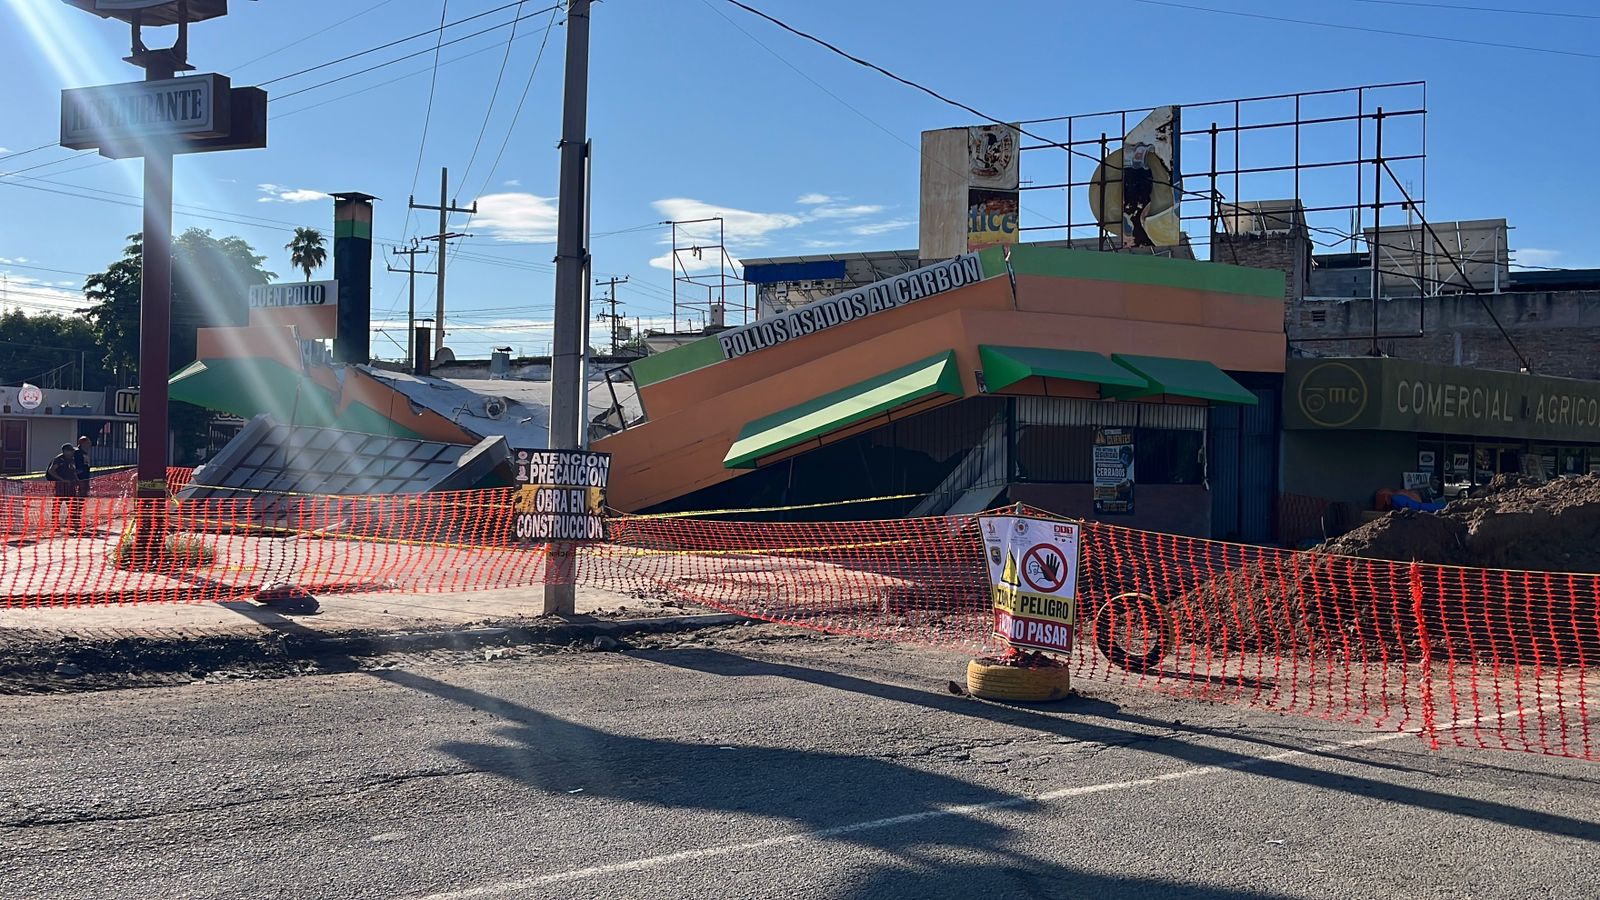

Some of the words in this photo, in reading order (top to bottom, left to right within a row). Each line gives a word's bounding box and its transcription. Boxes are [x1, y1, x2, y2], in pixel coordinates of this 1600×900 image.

[248, 286, 282, 307] BUEN
[286, 285, 323, 305] POLLO
[719, 318, 789, 360] POLLOS
[790, 293, 868, 339] ASADOS
[868, 287, 894, 313] AL
[893, 255, 980, 305] CARBÓN
[1397, 380, 1513, 422] COMERCIAL
[1535, 394, 1600, 427] AGRICO
[530, 452, 609, 468] ATENCIÓN
[529, 464, 608, 487] PRECAUCION
[536, 488, 568, 513] OBRA
[570, 489, 585, 513] EN
[516, 509, 603, 539] CONSTRUCCIÓN
[1020, 595, 1069, 620] PELIGRO
[1027, 621, 1068, 647] PASAR
